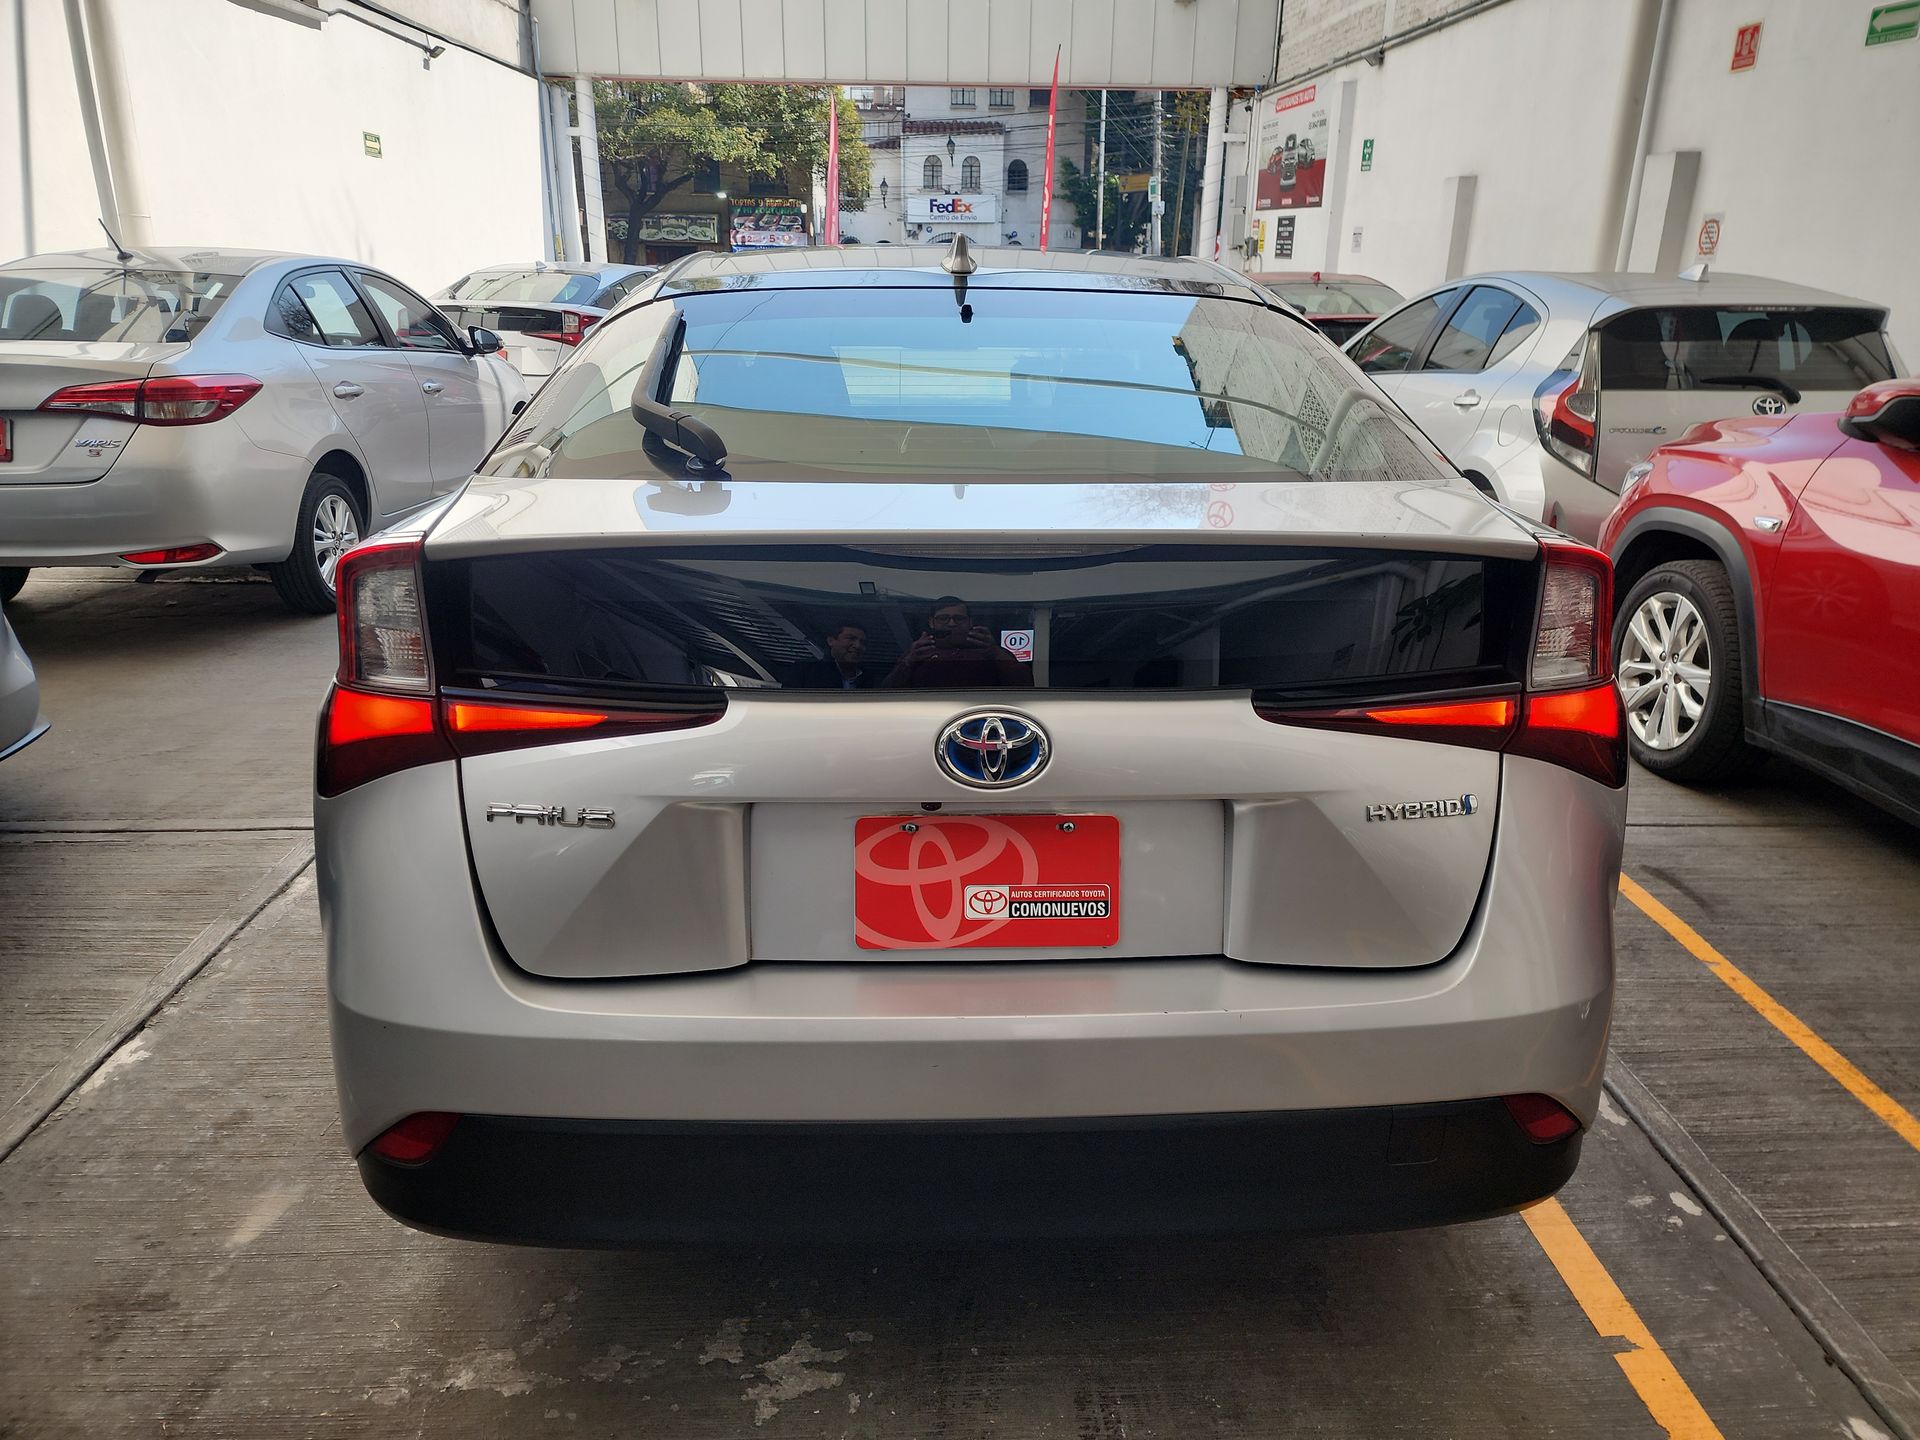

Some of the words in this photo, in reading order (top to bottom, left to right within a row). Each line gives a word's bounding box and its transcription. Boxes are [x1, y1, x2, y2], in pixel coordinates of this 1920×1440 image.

[929, 198, 972, 213] FedEx
[74, 439, 122, 448] YARIS
[486, 801, 616, 829] PRIUS
[1366, 799, 1461, 822] HYBRID
[1081, 890, 1105, 898] TOYOTA
[1011, 902, 1106, 917] COMONUEVOS
